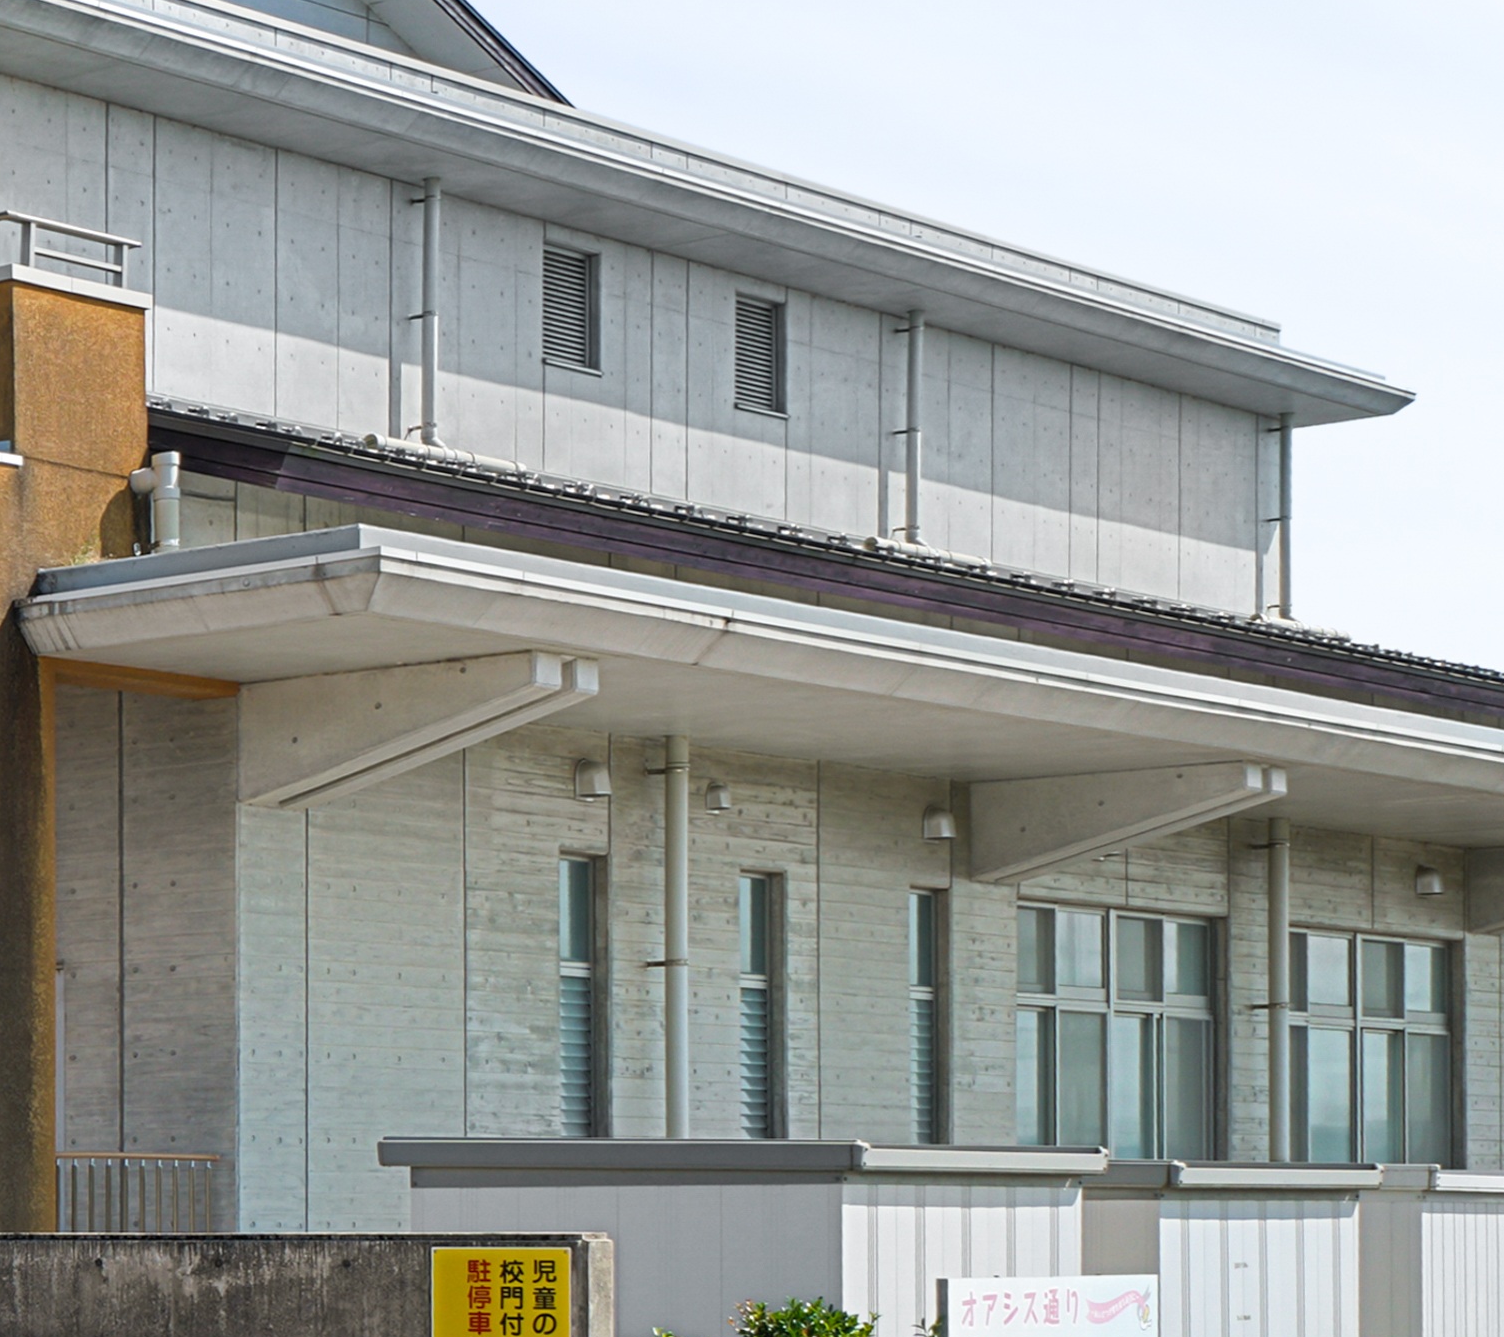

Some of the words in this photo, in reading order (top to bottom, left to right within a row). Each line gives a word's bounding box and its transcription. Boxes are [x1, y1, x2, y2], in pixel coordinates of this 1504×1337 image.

[962, 1288, 1078, 1327] オアシス通り
